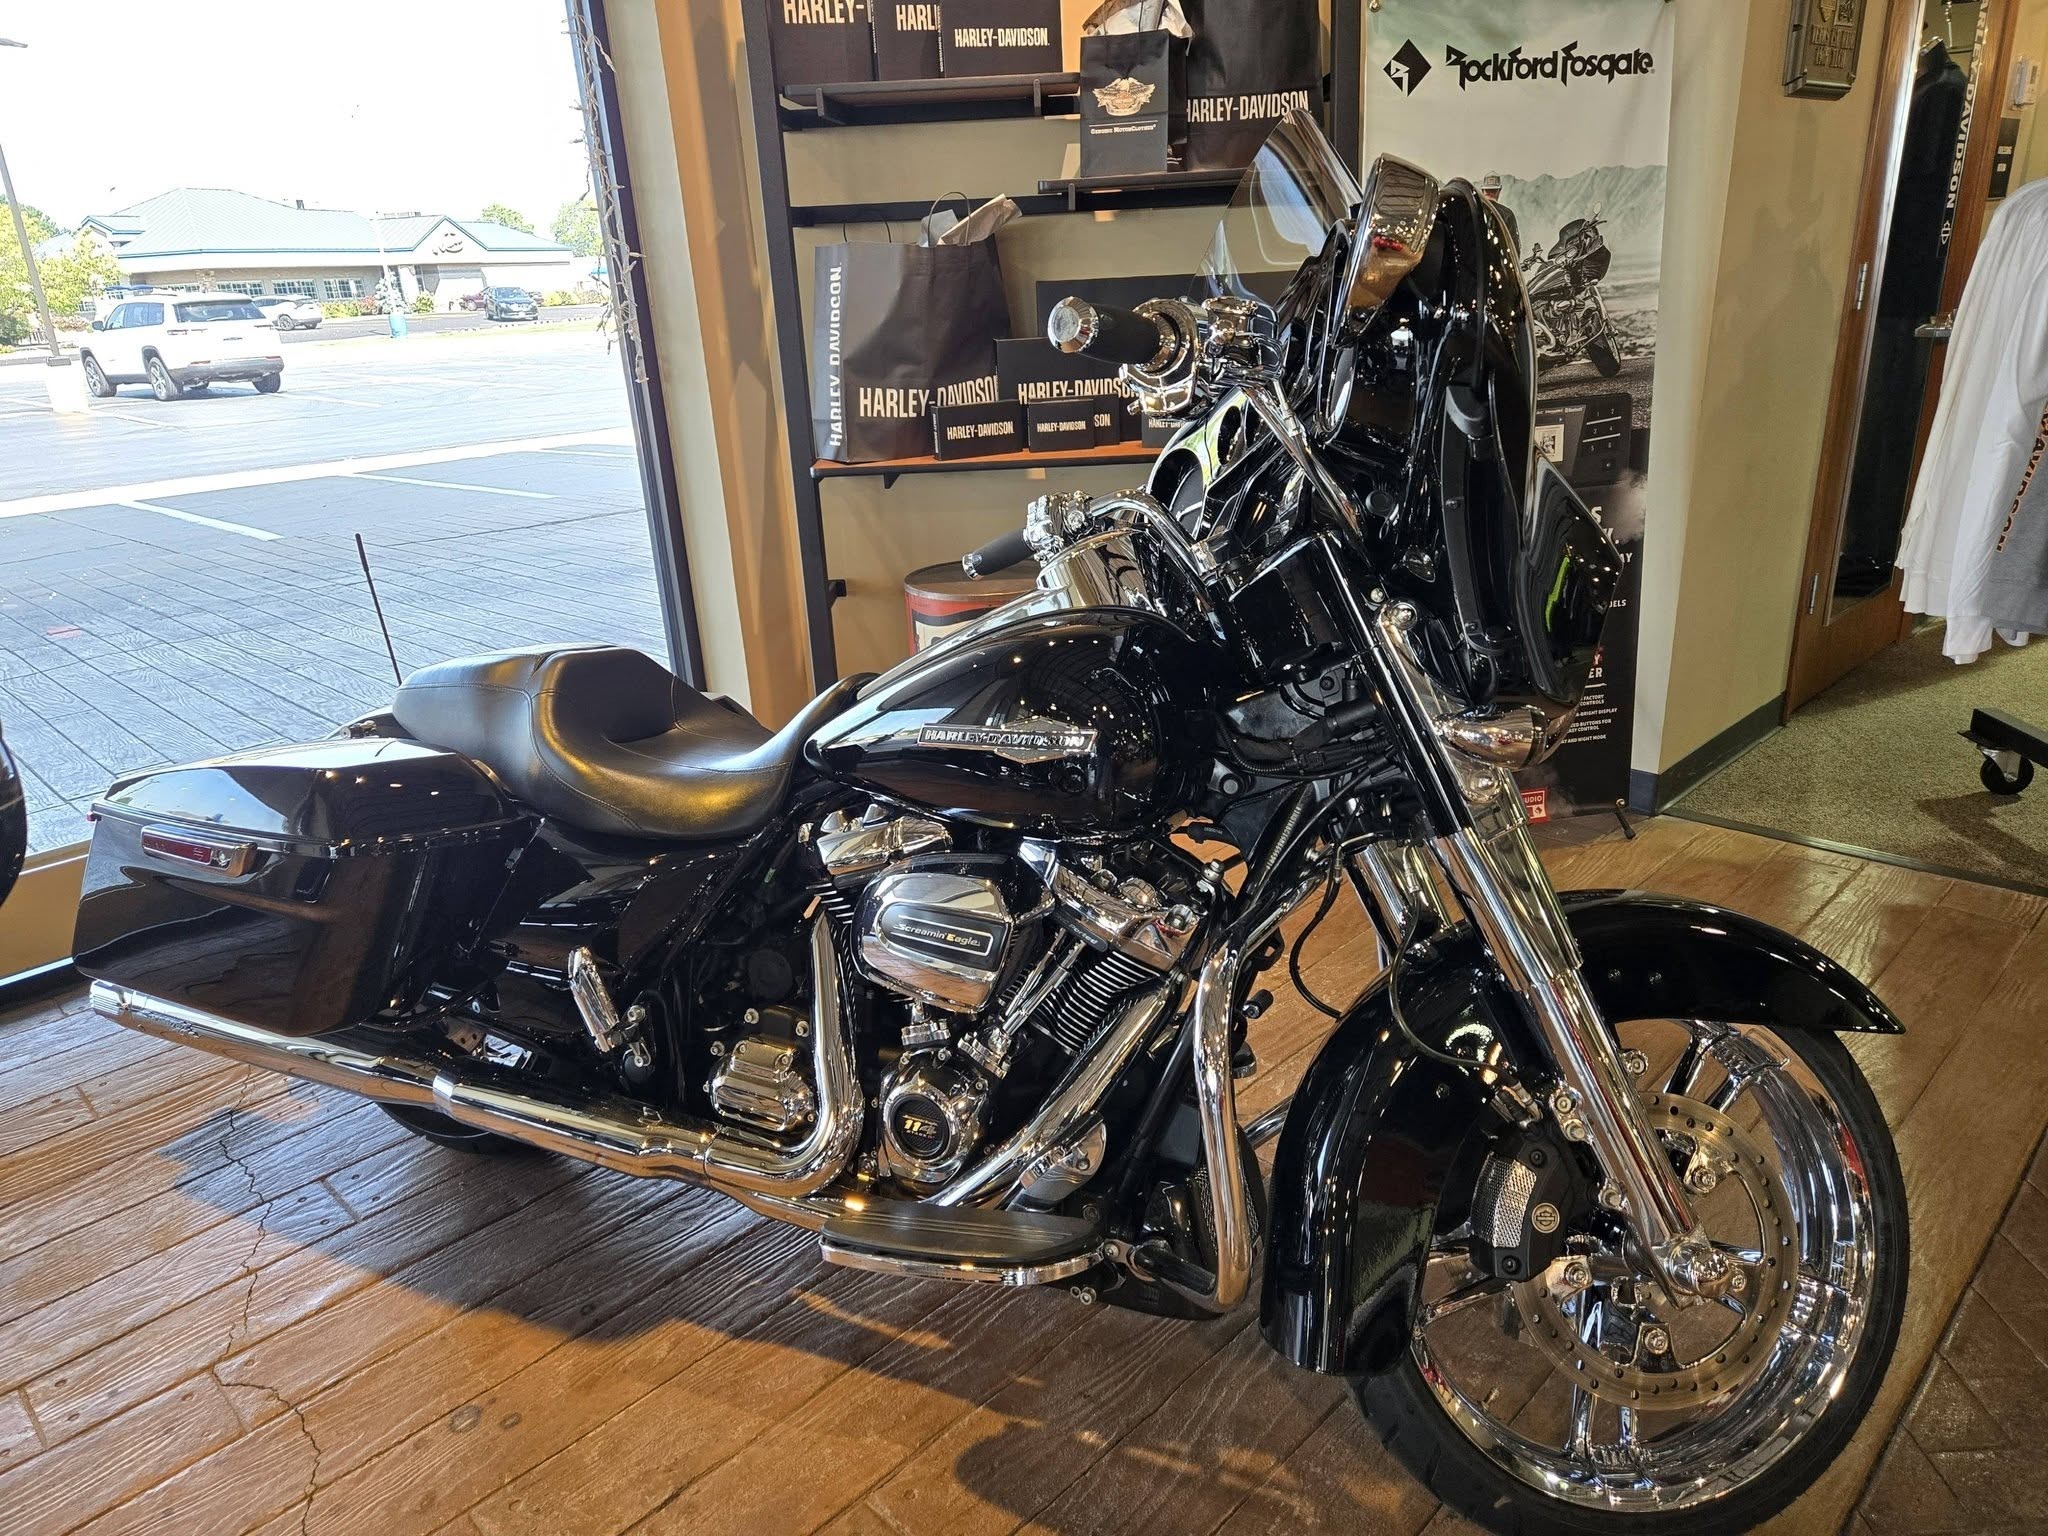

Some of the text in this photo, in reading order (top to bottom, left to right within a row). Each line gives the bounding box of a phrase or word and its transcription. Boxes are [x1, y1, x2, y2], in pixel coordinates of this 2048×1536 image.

[1446, 40, 1655, 92] Rockford Fosgate
[904, 1119, 937, 1135] 114
